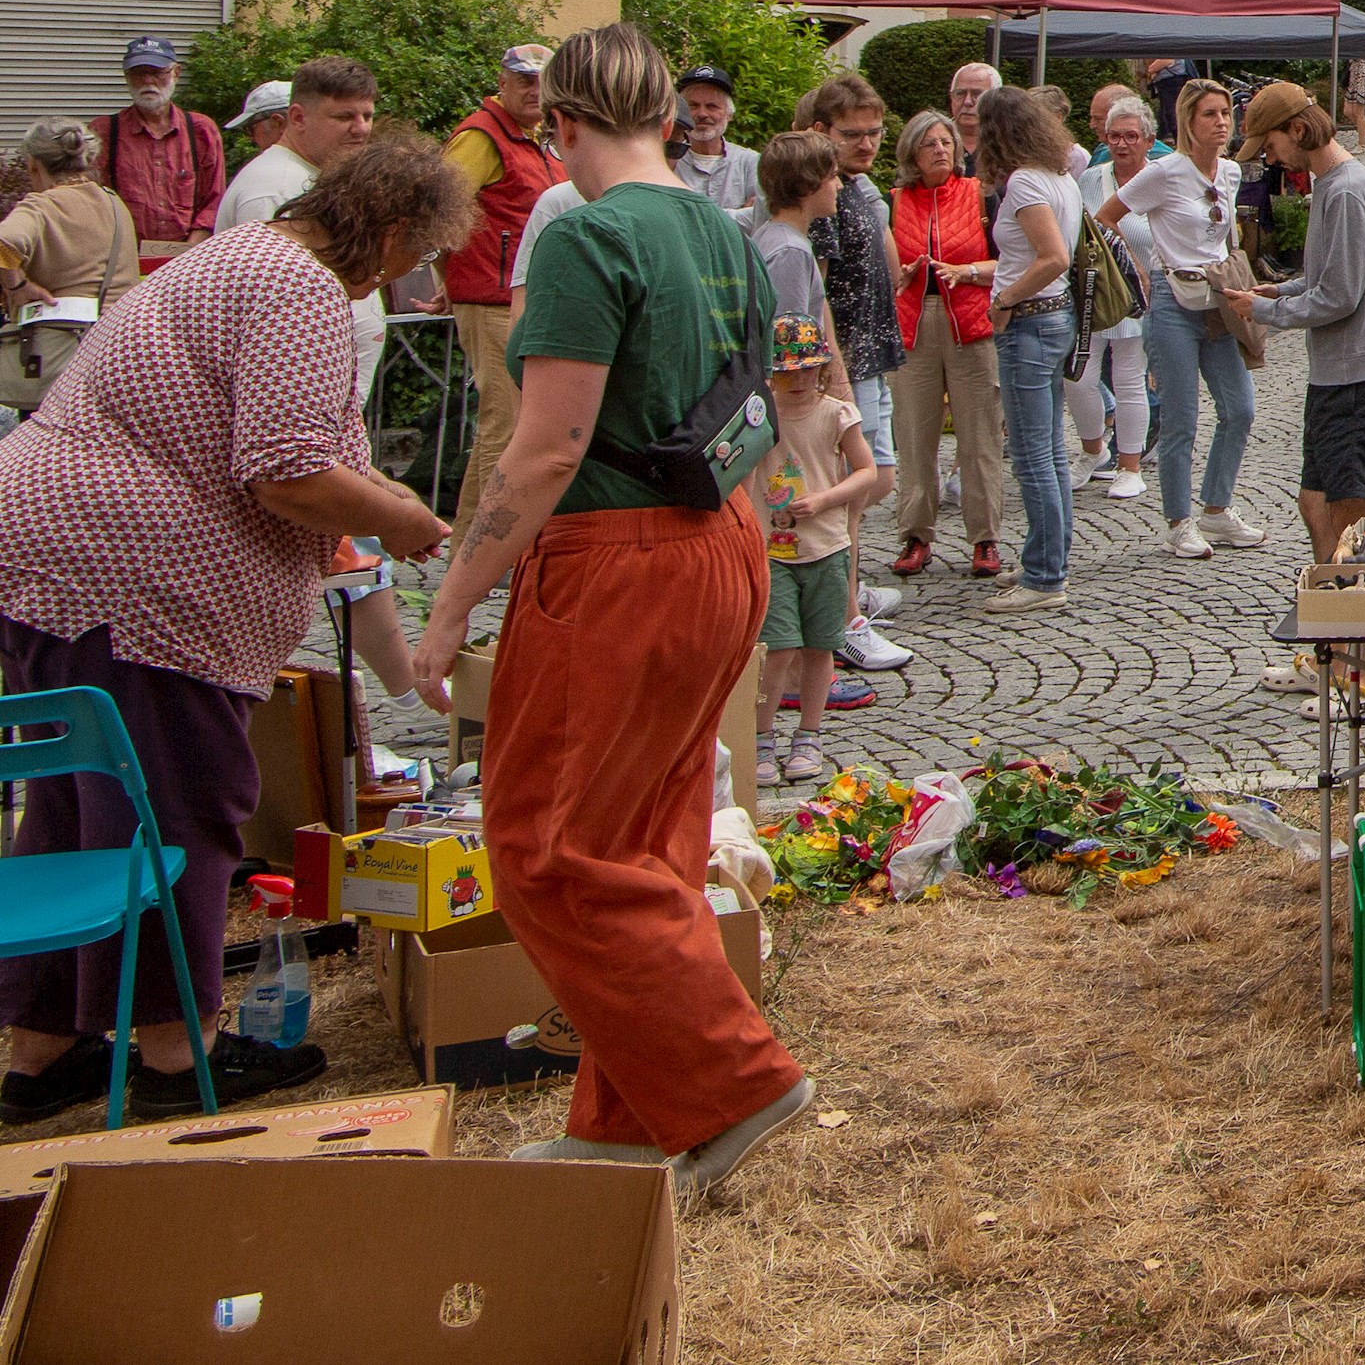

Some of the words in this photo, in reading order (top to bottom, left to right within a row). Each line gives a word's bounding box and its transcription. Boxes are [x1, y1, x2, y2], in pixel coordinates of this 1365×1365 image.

[1081, 298, 1093, 351] COLLECTION
[363, 854, 395, 874] Royal
[397, 859, 418, 873] Vine
[11, 1135, 110, 1154] FIRST
[120, 1114, 268, 1140] QUALITY
[273, 1095, 425, 1122] BANANAS
